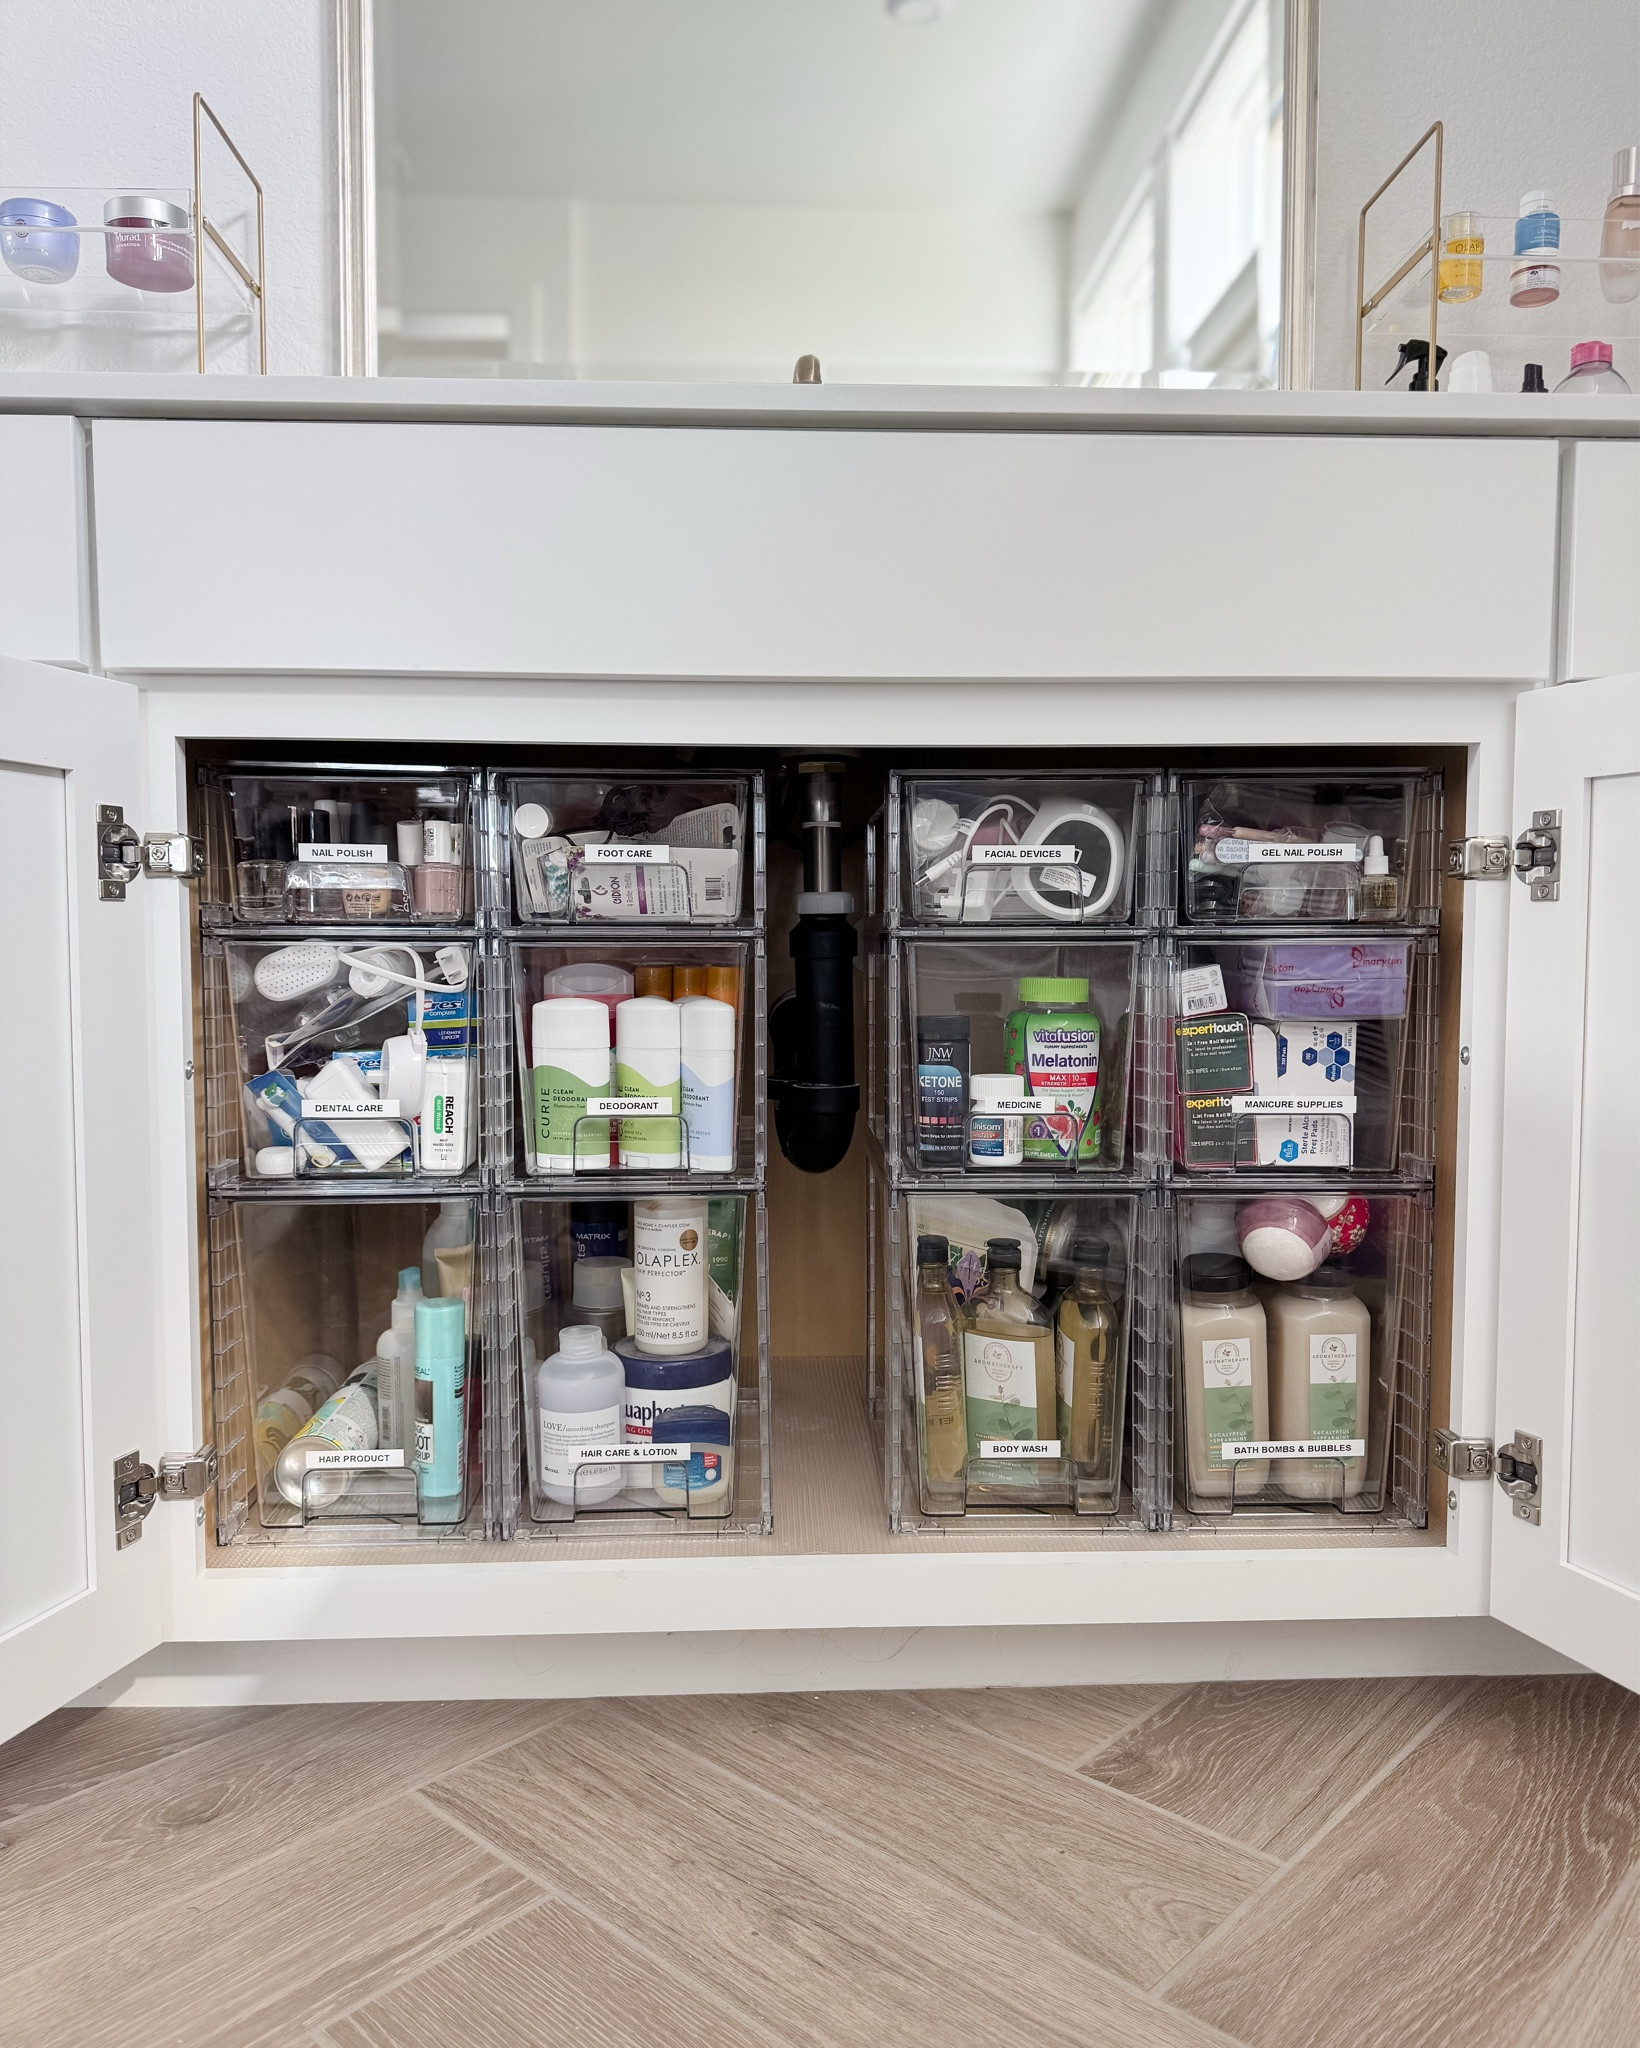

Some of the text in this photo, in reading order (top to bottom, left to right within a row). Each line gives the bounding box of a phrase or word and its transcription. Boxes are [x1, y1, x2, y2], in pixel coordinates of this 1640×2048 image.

[311, 849, 373, 858] NAIL POLISH
[597, 850, 653, 858] FOOT CARE
[984, 850, 1062, 858] FACIAL DEVICES
[1261, 849, 1343, 857] GEL NAIL POLISH
[1176, 1021, 1244, 1037] experttouch
[1033, 1028, 1096, 1043] vitafusion
[925, 1047, 954, 1062] JNW
[1032, 1053, 1097, 1068] Melatonin
[919, 1075, 962, 1088] KETONE
[682, 1093, 709, 1101] DEODORANT
[315, 1104, 384, 1112] DENTAL CARE
[599, 1102, 659, 1110] DEODORANT
[997, 1101, 1042, 1109] MEDICINE
[1186, 1097, 1233, 1110] expertto
[1244, 1100, 1344, 1109] MANICURE SUPPLIES
[445, 1096, 454, 1134] REACH
[541, 1088, 550, 1139] CURIE
[972, 1121, 1001, 1131] Unisom
[1311, 1119, 1319, 1138] Pads
[576, 1232, 611, 1240] MATRIX
[671, 1331, 684, 1340] 8.5
[973, 1358, 1024, 1371] AROMATHERAPY
[581, 1450, 603, 1458] HAIR
[605, 1449, 631, 1457] CARE
[642, 1448, 678, 1456] LOTION
[992, 1445, 1048, 1453] BODY WASH
[1234, 1444, 1352, 1454] BATH BOMBS & BUBBLES
[318, 1454, 390, 1463] HAIR PRODUCT
